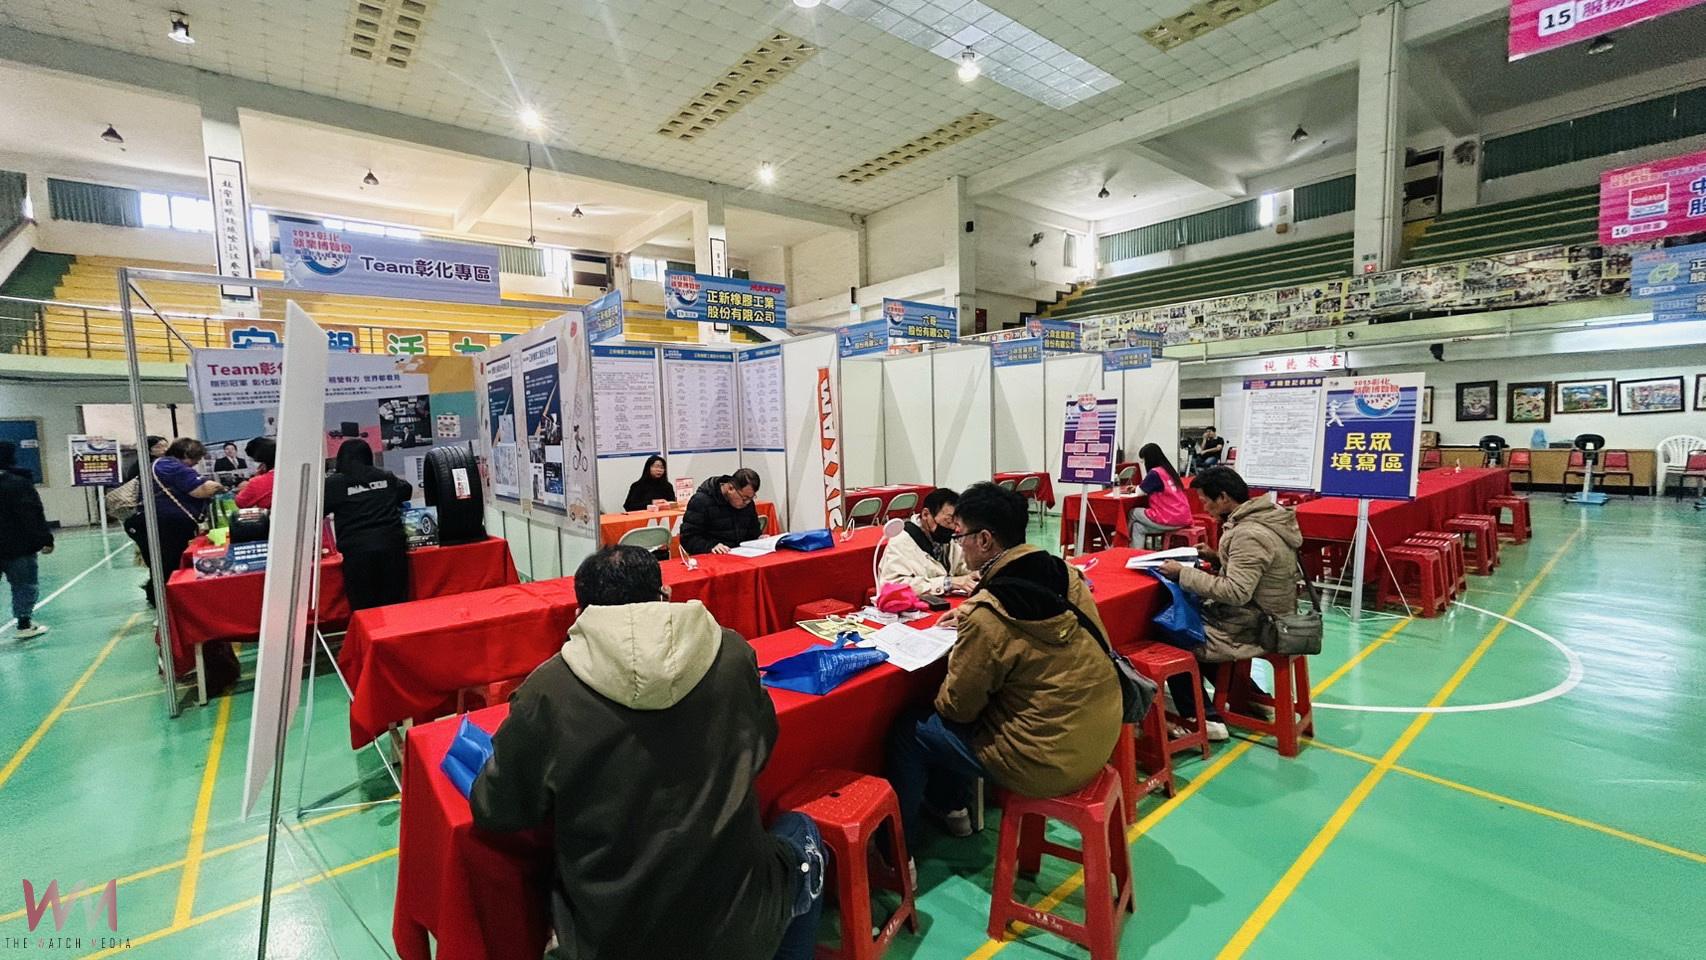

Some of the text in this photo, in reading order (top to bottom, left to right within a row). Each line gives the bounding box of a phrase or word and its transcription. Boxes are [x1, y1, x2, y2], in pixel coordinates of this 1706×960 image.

[1544, 9, 1571, 30] 15
[360, 256, 491, 283] Team彰化專區
[707, 306, 775, 324] 股份有限公司
[1343, 432, 1393, 451] 民眾
[1330, 453, 1405, 473] 填寫區
